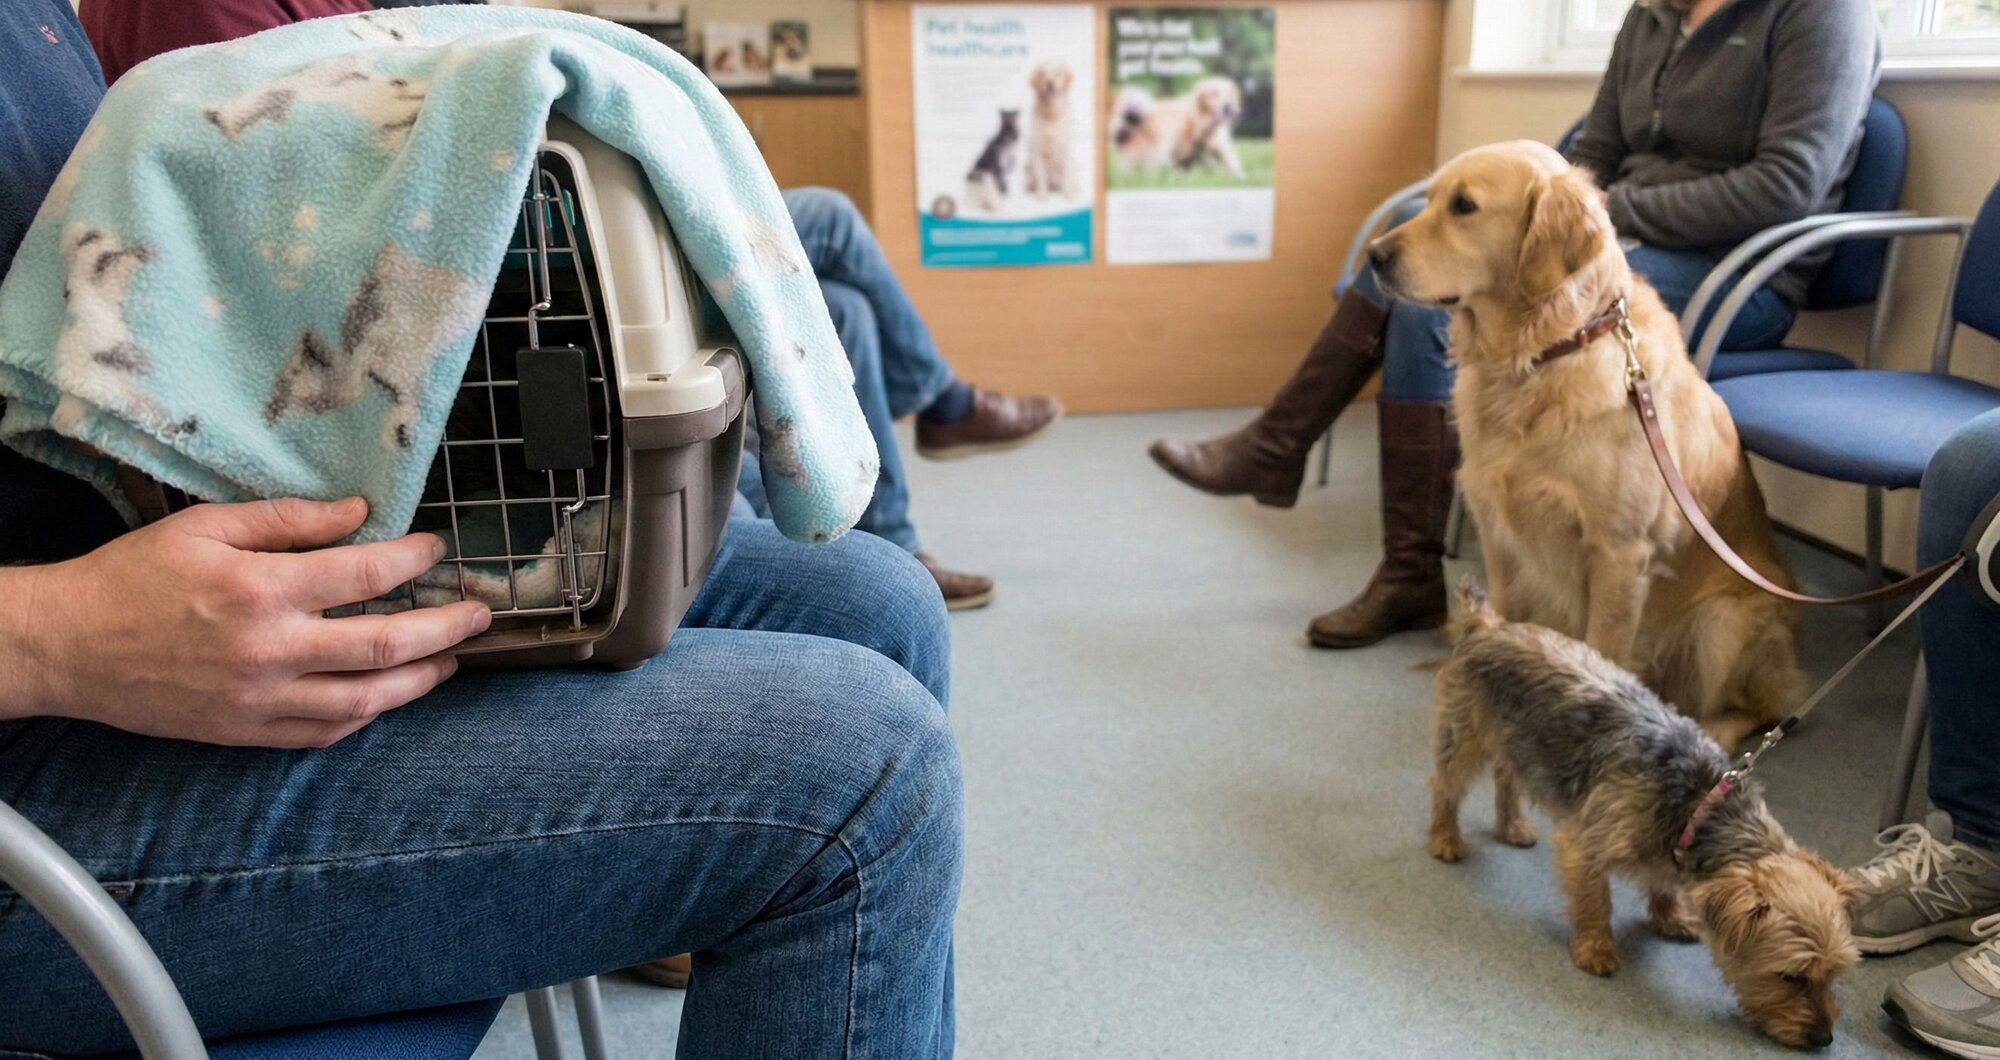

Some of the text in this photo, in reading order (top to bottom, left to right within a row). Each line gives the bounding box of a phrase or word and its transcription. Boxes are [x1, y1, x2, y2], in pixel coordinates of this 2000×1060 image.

[926, 18, 1024, 34] Pet health
[926, 40, 1029, 57] healthcare
[1909, 875, 1972, 922] N
